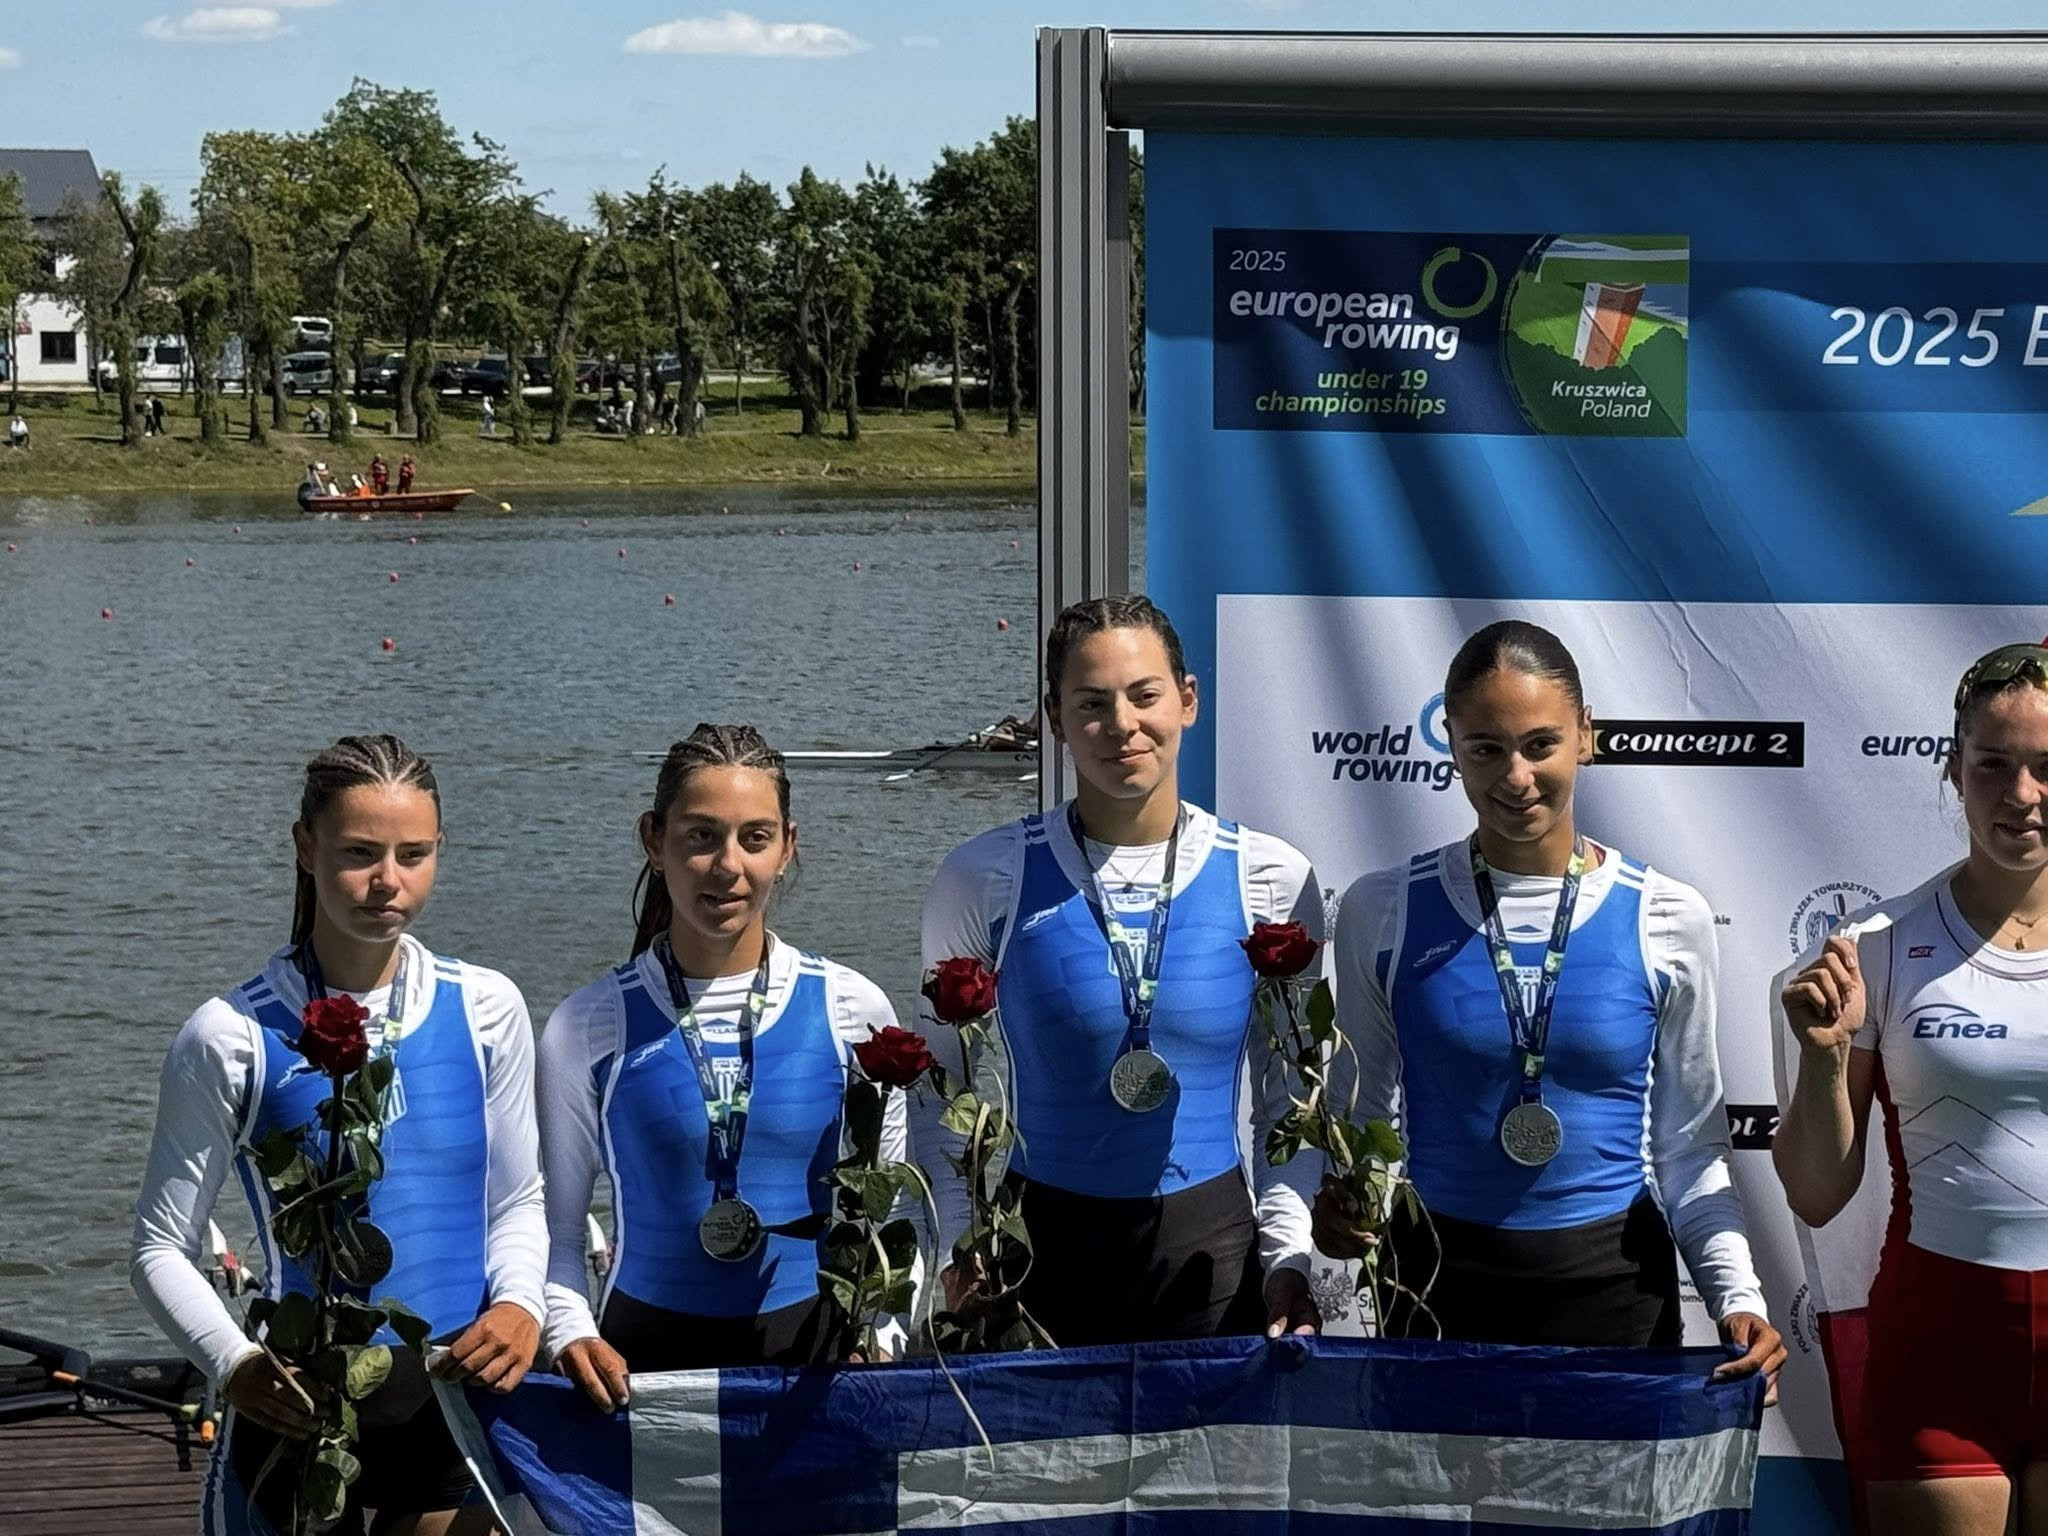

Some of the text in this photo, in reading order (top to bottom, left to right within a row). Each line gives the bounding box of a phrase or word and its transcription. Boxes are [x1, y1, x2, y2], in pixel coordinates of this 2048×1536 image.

[1229, 249, 1287, 272] 2025
[1229, 289, 1413, 327] european
[1324, 320, 1460, 361] rowing
[1822, 306, 2005, 368] 2025
[1317, 368, 1428, 391] under 19
[1551, 380, 1647, 399] Kruszwica
[1255, 391, 1447, 420] championships
[1580, 398, 1651, 419] Poland
[1312, 725, 1413, 756] world
[1609, 733, 1788, 756] concept 2
[1332, 758, 1456, 792] rowing
[1913, 1017, 2008, 1039] Enea
